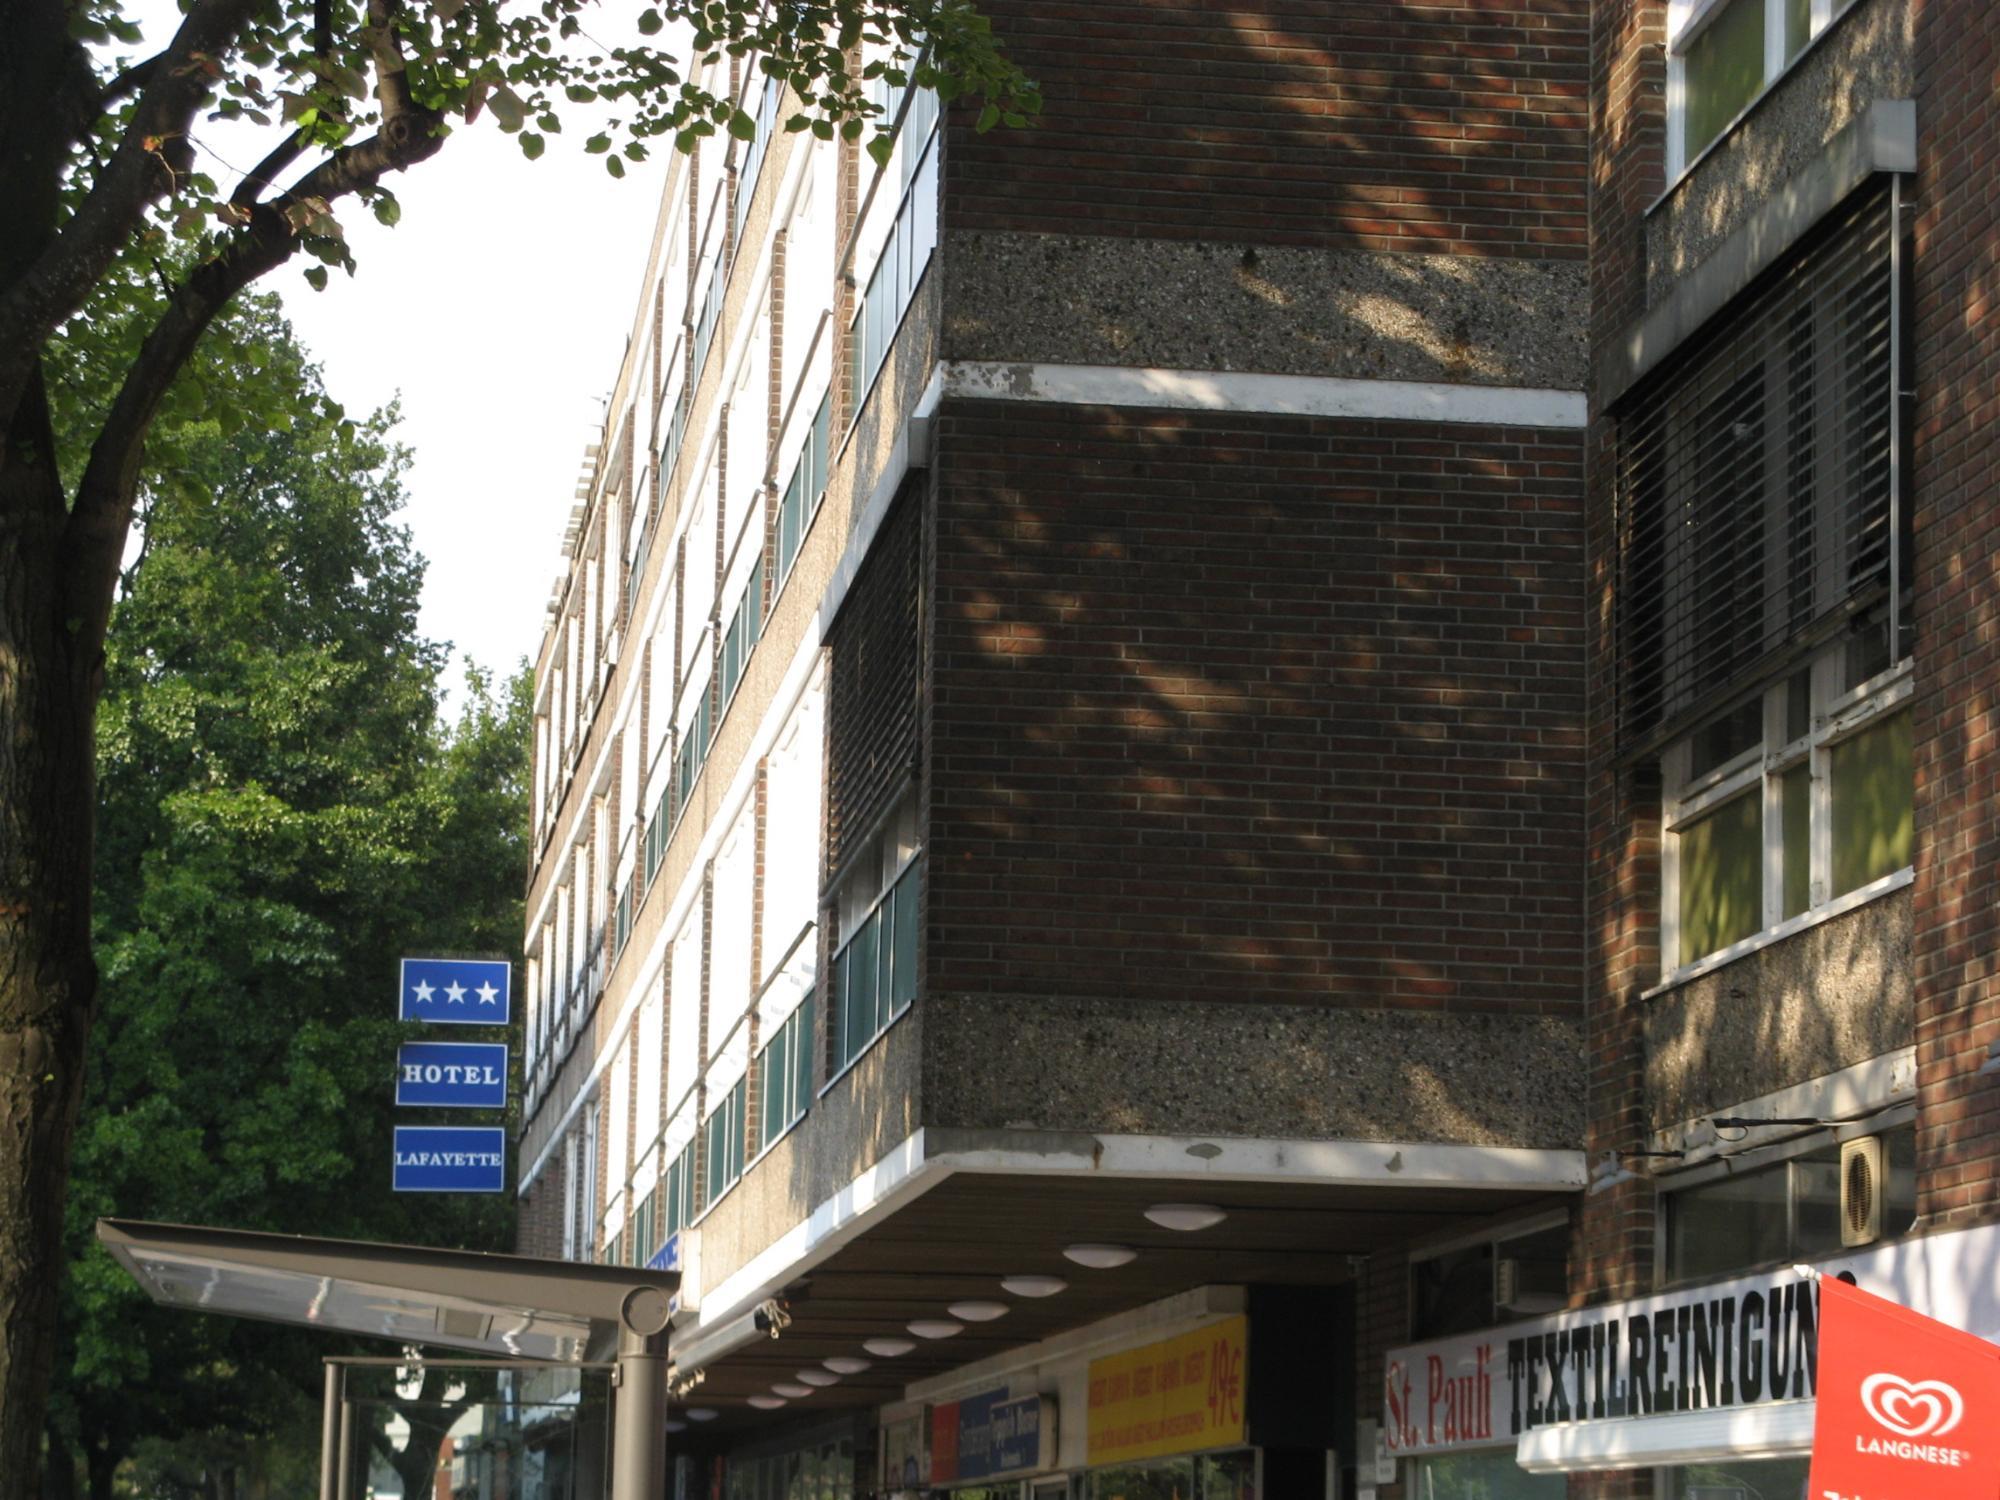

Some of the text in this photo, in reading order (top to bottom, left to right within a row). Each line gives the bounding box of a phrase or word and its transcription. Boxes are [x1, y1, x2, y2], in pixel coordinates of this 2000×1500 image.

[403, 1063, 500, 1085] HOTEL
[396, 1152, 502, 1167] LAFAYETTE
[1386, 1271, 1857, 1450] St. Pauli TEXTILREINIGUN
[1855, 1435, 1962, 1467] LANGNESE
